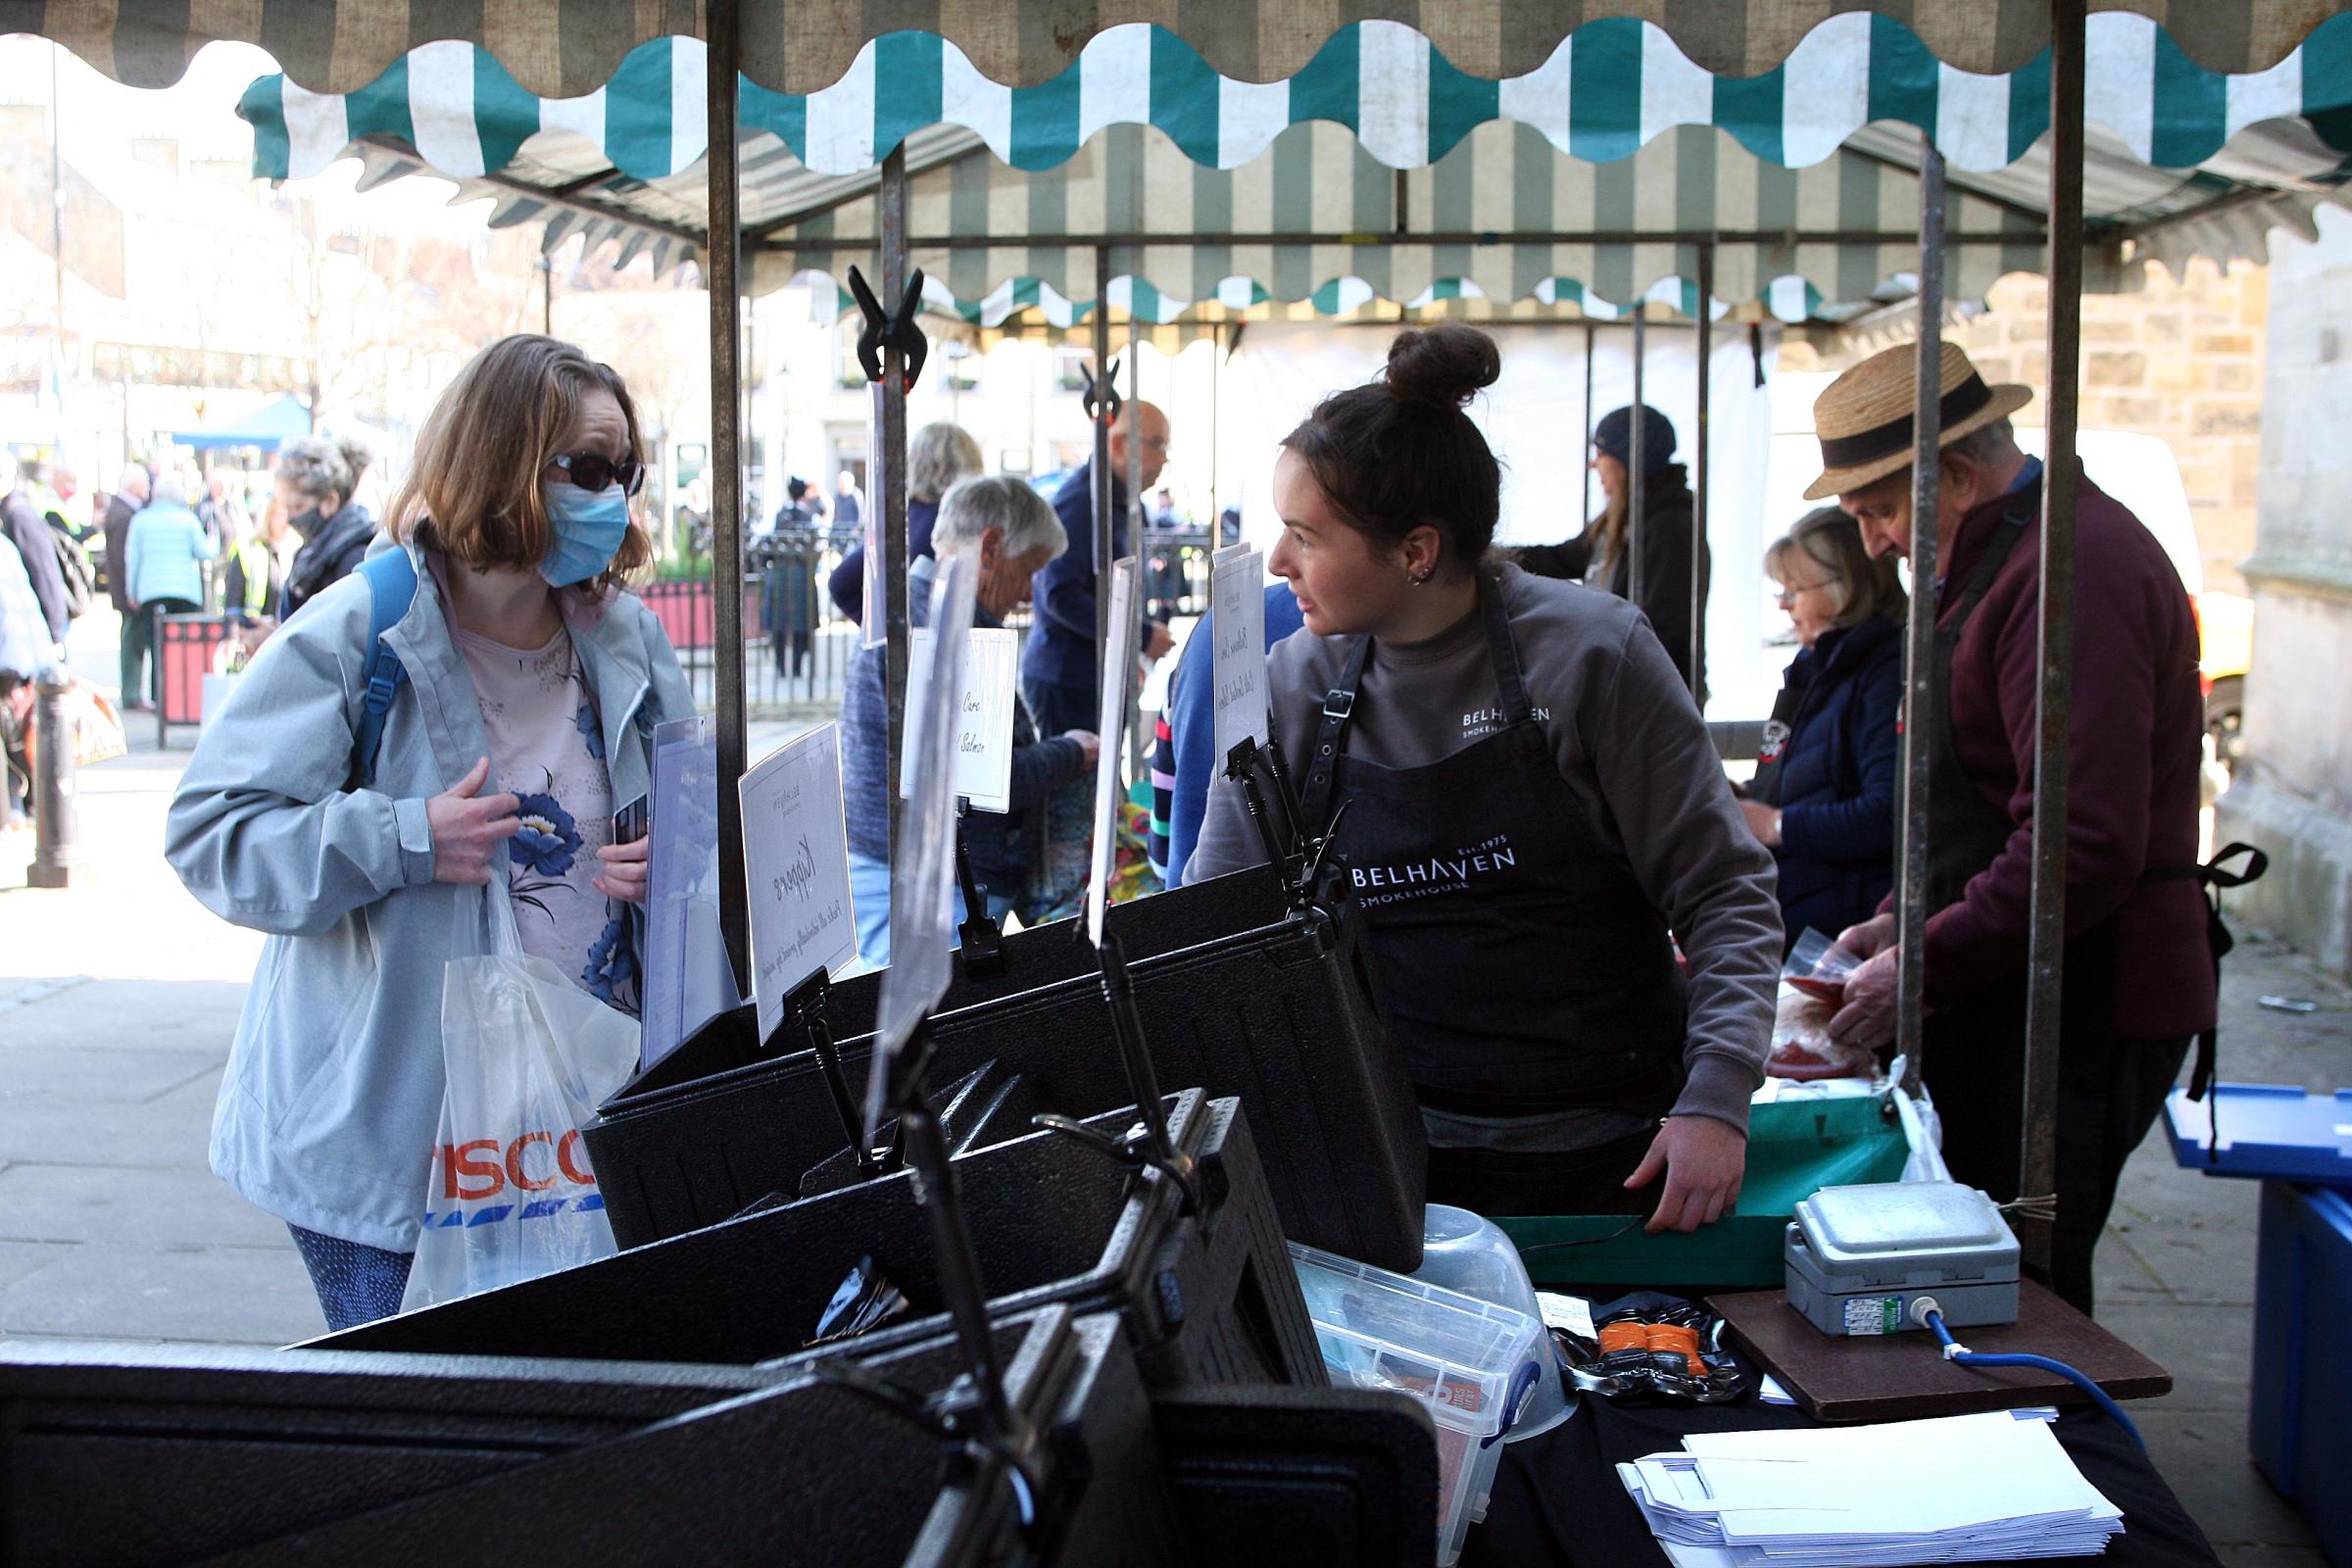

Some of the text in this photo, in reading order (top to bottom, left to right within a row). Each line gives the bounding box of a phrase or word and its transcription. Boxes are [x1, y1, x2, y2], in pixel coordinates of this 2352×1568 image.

[1463, 708, 1550, 726] BELHEN
[1351, 848, 1516, 888] BELHAVEN
[1359, 882, 1471, 908] SMOKEHOUSE
